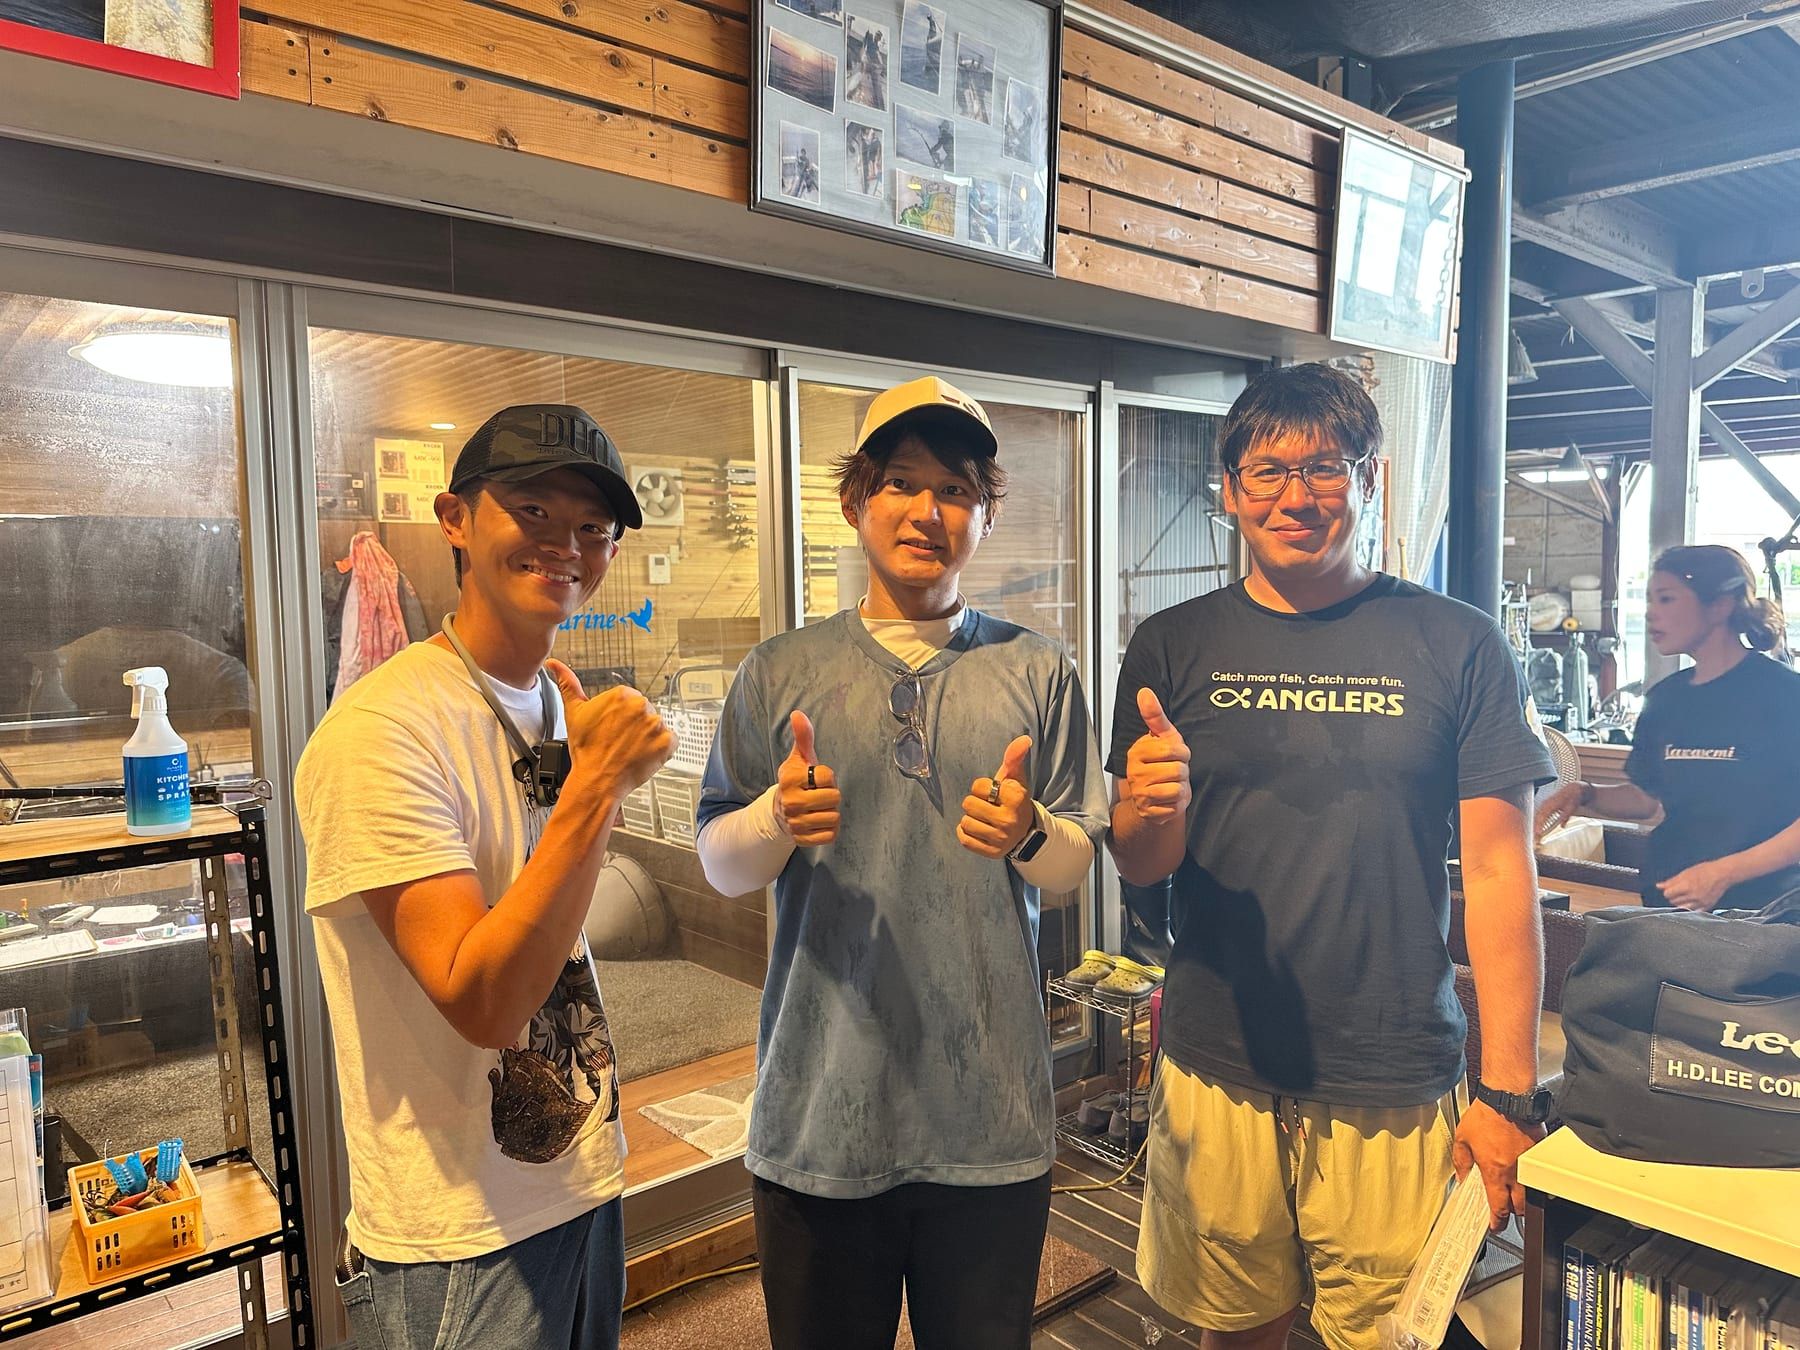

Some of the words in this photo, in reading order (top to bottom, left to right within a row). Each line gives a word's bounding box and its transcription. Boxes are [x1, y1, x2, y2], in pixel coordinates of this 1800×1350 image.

[1211, 671, 1244, 683] Catch
[1247, 673, 1276, 683] more
[1279, 673, 1305, 685] fish,
[1308, 674, 1344, 685] Catch
[1346, 675, 1378, 686] more
[1380, 675, 1405, 688] fun.
[1256, 688, 1404, 717] ANGLERS
[1667, 1059, 1753, 1090] H.D.LEE
[1565, 1272, 1579, 1301] GEAR
[1585, 1264, 1595, 1302] YAMAHA
[1584, 1302, 1594, 1342] MARINE
